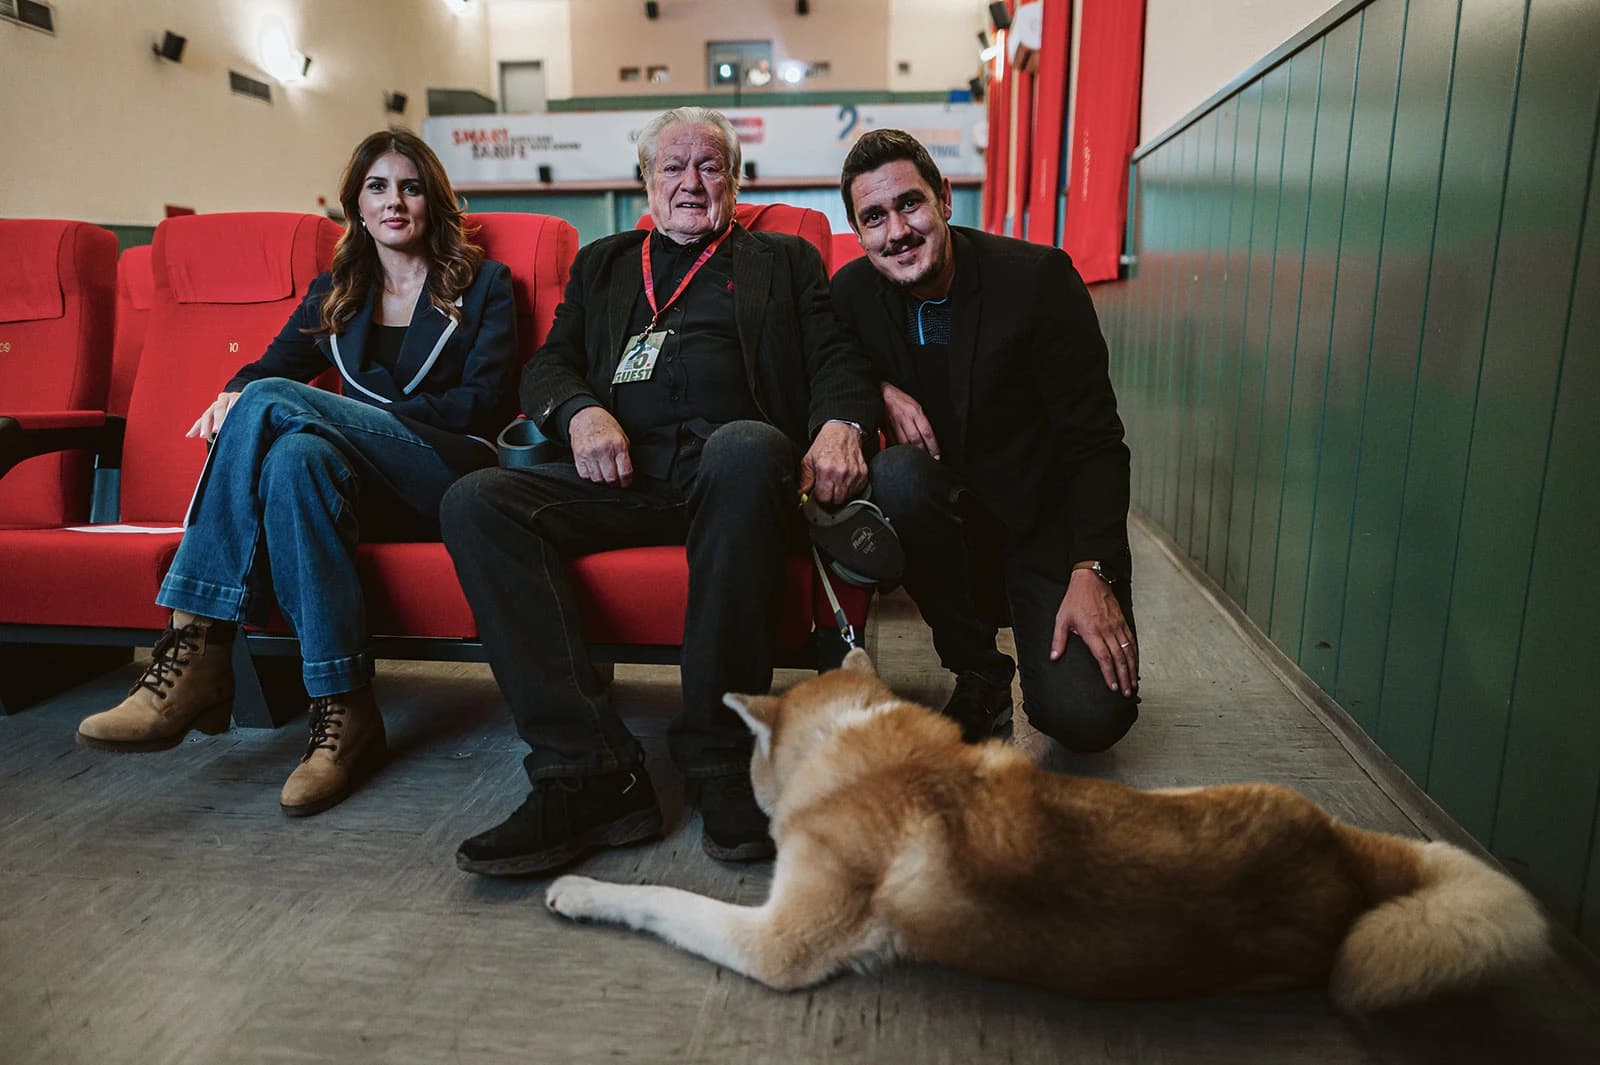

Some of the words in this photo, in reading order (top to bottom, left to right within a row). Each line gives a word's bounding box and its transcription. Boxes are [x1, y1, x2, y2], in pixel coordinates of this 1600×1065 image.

[452, 128, 508, 145] SMART
[229, 342, 239, 353] 10
[615, 369, 651, 381] GUEST
